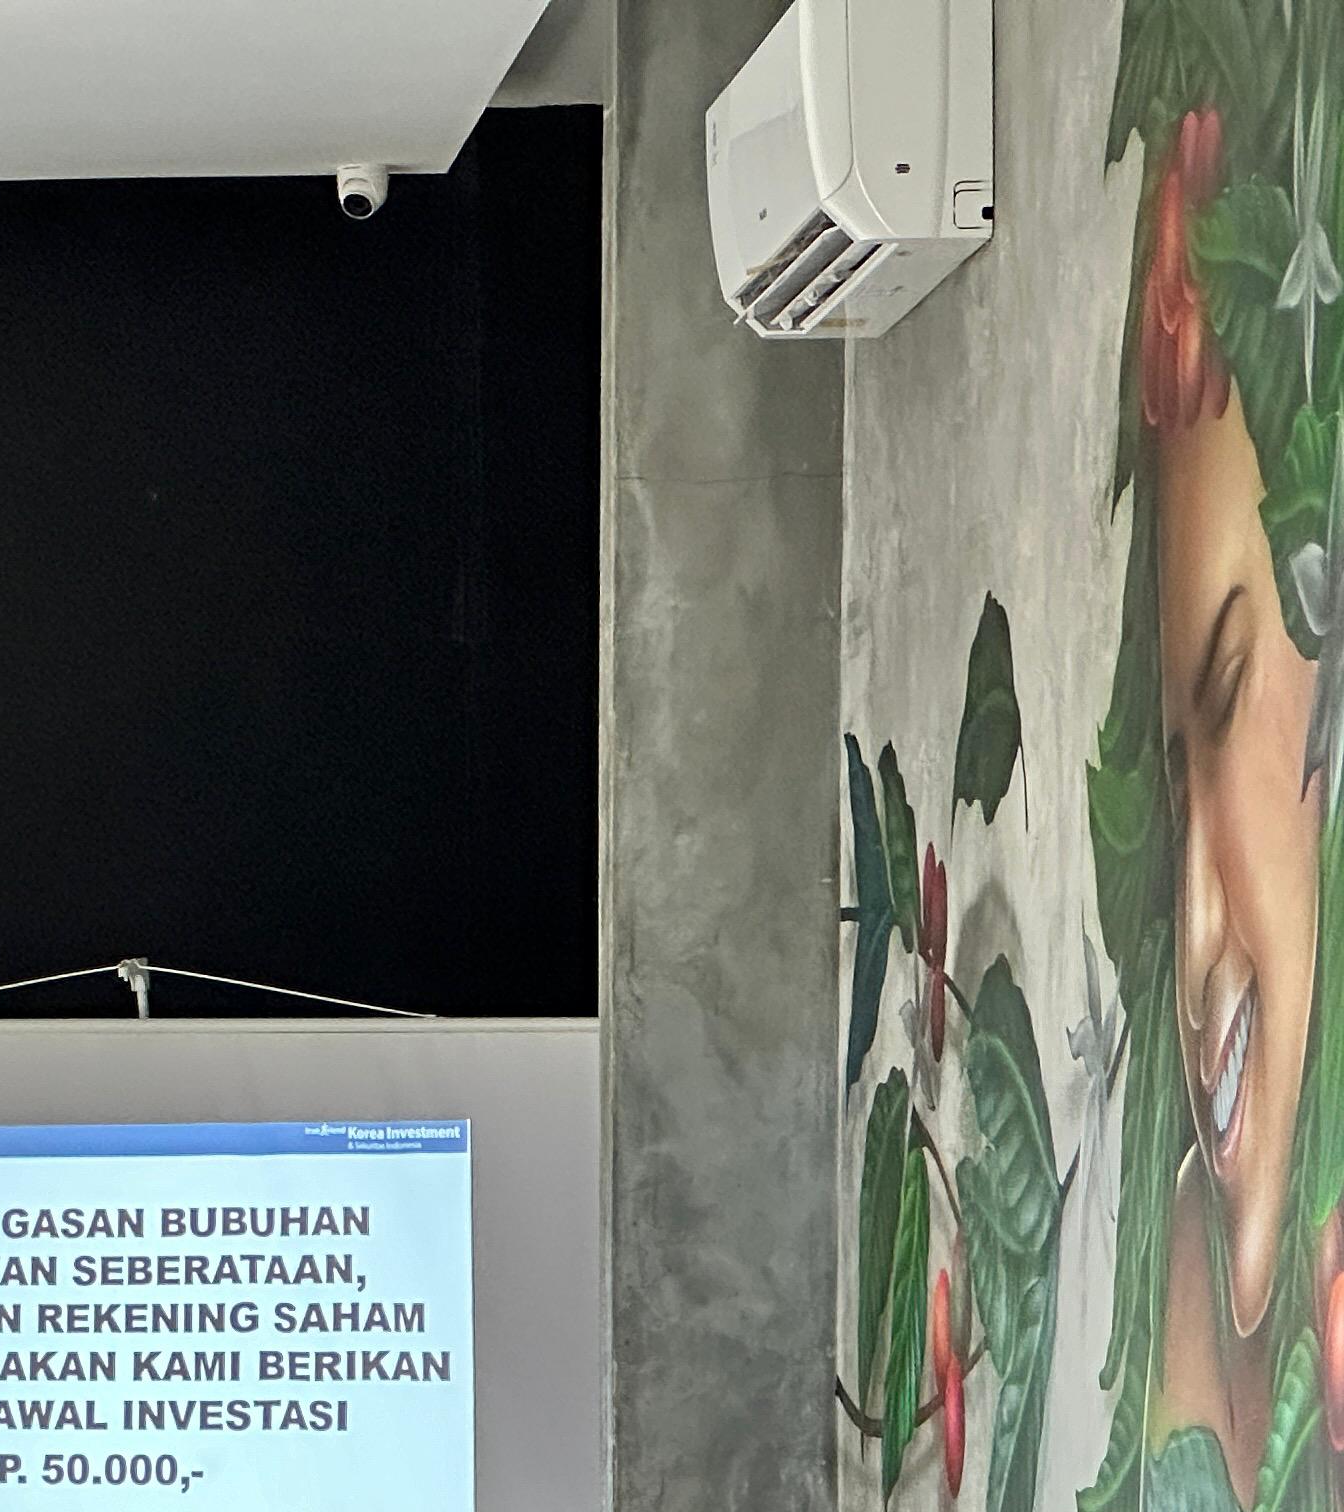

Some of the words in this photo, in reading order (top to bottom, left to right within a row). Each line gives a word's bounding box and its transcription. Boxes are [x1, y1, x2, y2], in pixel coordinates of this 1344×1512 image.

[348, 1127, 384, 1140] Korea
[386, 1126, 460, 1139] Investment
[1, 1208, 145, 1240] GASAN
[161, 1206, 370, 1238] BUBUHAN
[72, 1253, 367, 1293] SEBERATAAN,
[37, 1301, 259, 1334] REKENING
[274, 1302, 425, 1334] SAHAM
[132, 1351, 241, 1382] KAMI
[258, 1350, 451, 1382] BERIKAN
[123, 1399, 348, 1432] INVESTASI
[41, 1453, 204, 1494] 50.000,-
